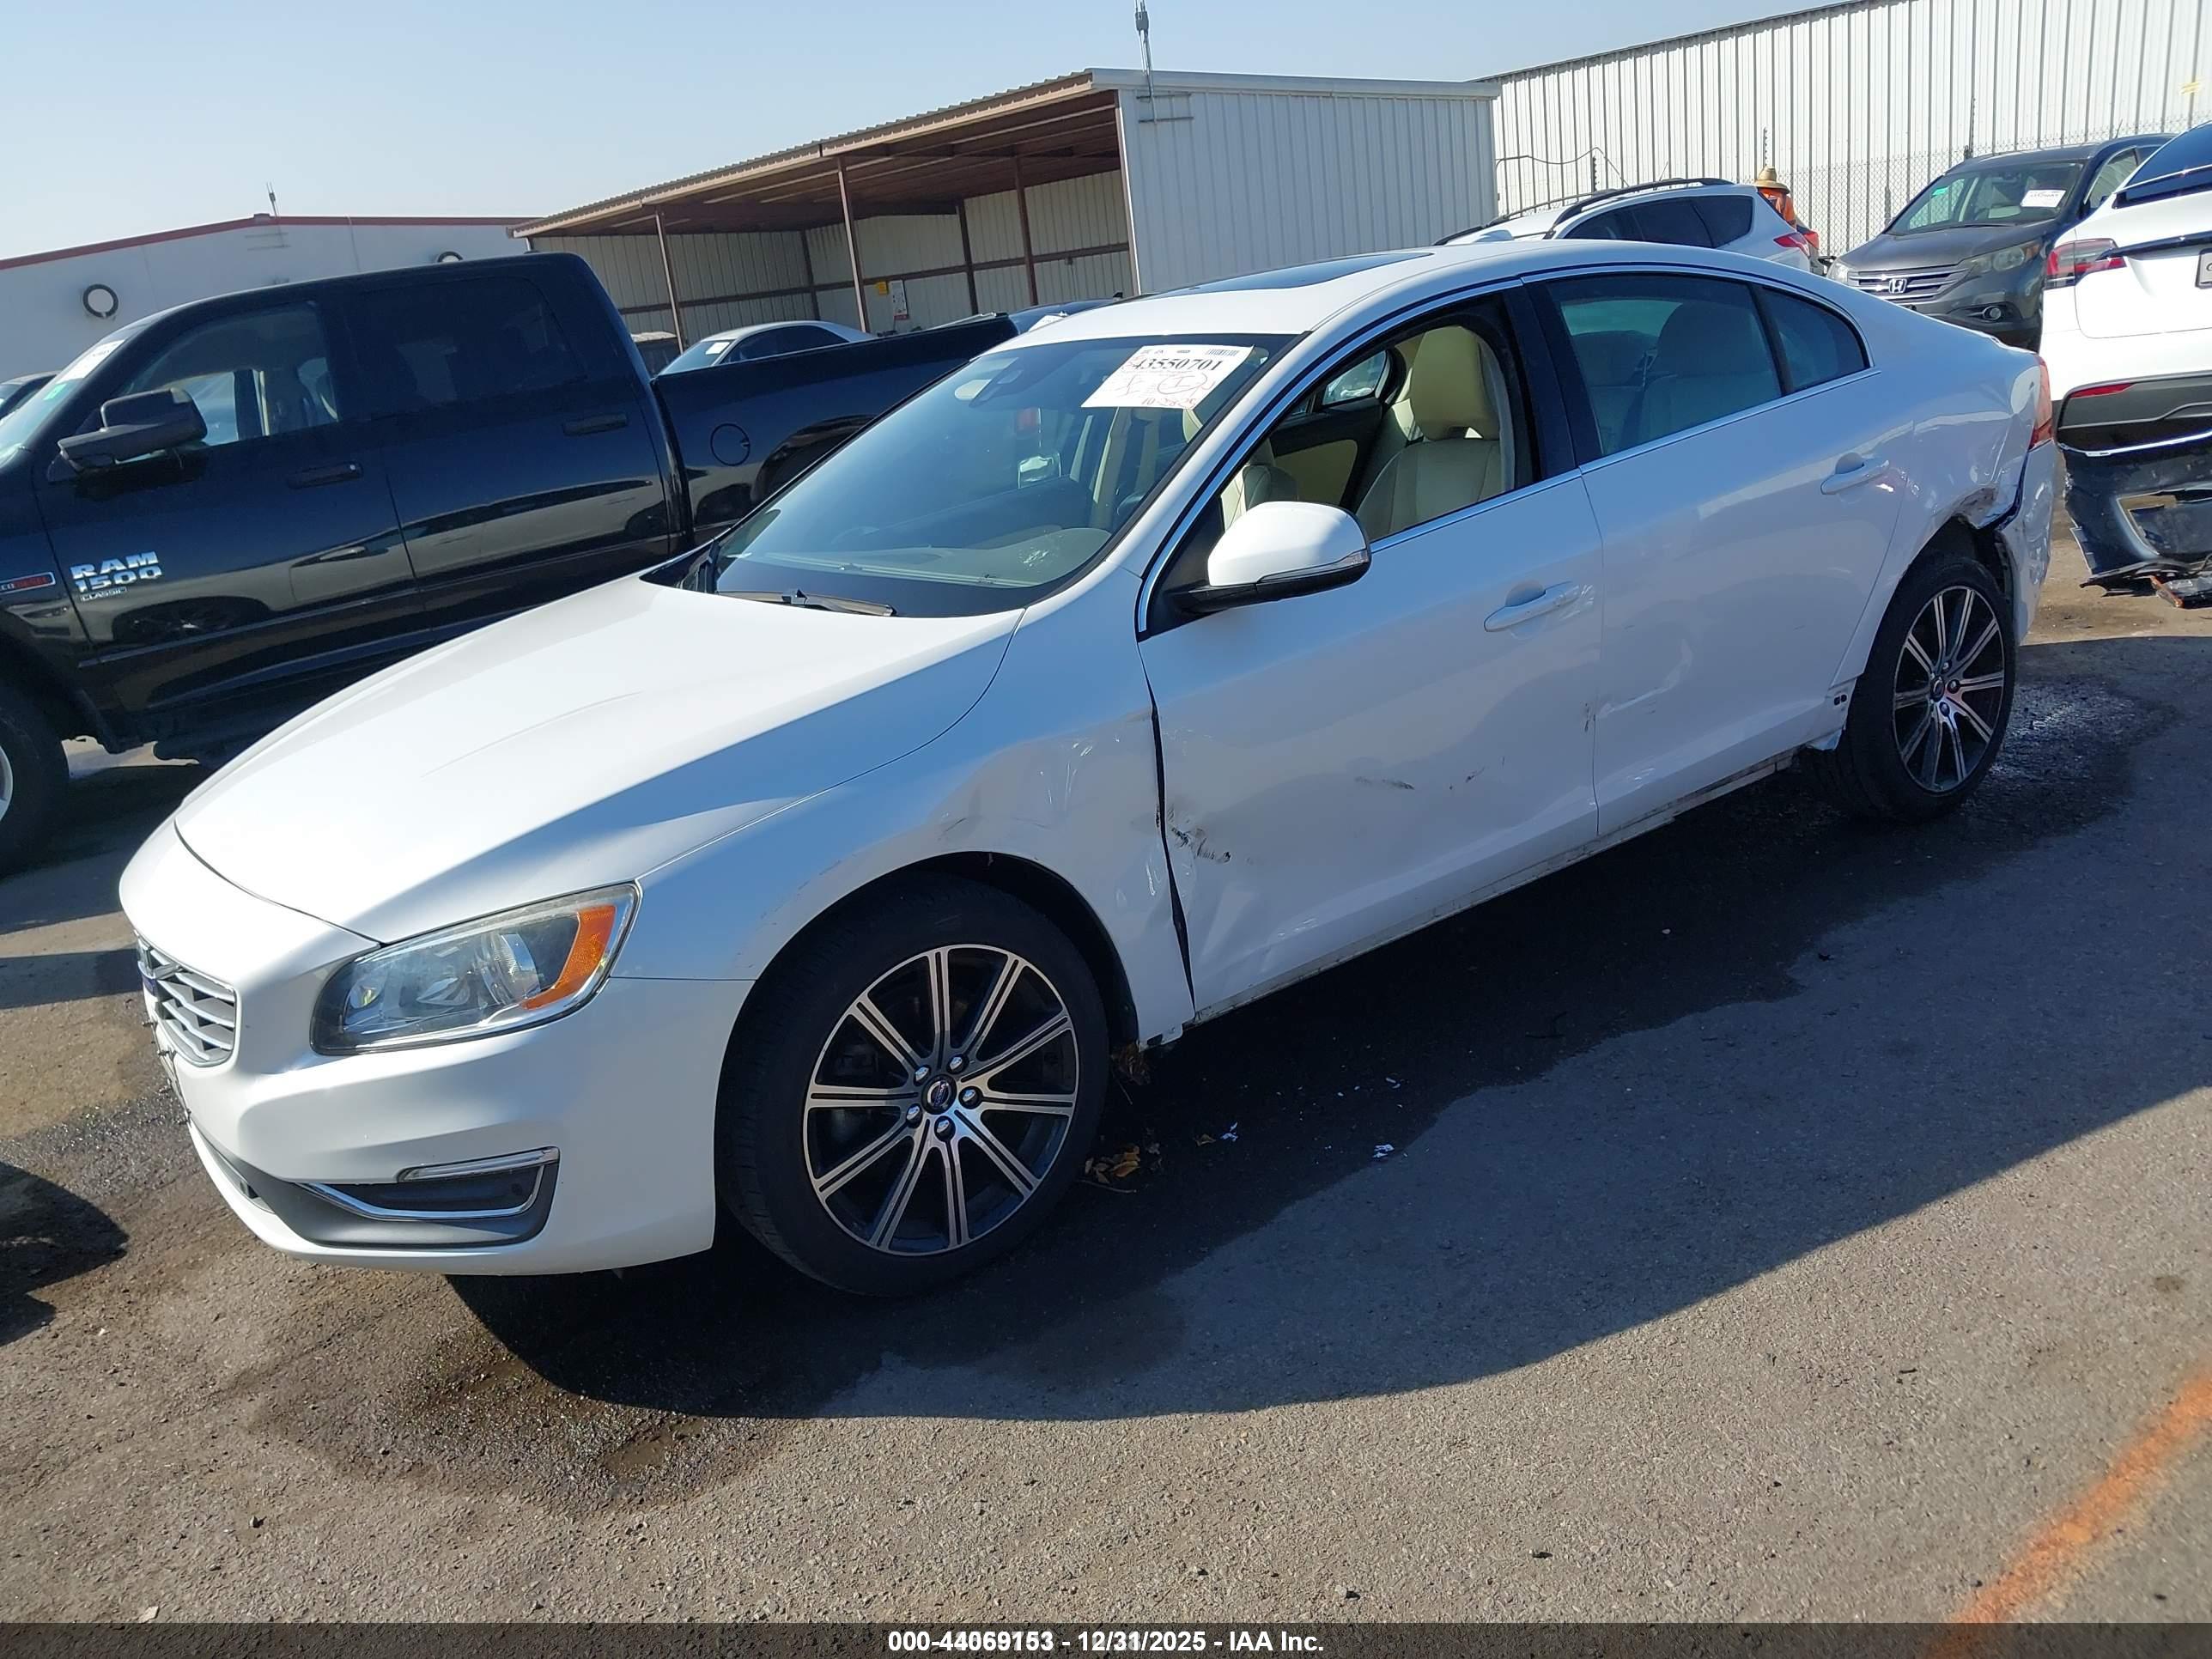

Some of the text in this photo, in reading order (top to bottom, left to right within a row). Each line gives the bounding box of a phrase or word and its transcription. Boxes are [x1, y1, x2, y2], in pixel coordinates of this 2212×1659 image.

[1133, 357, 1224, 371] 43550701
[70, 550, 159, 580] RAM
[75, 565, 162, 593] 1500
